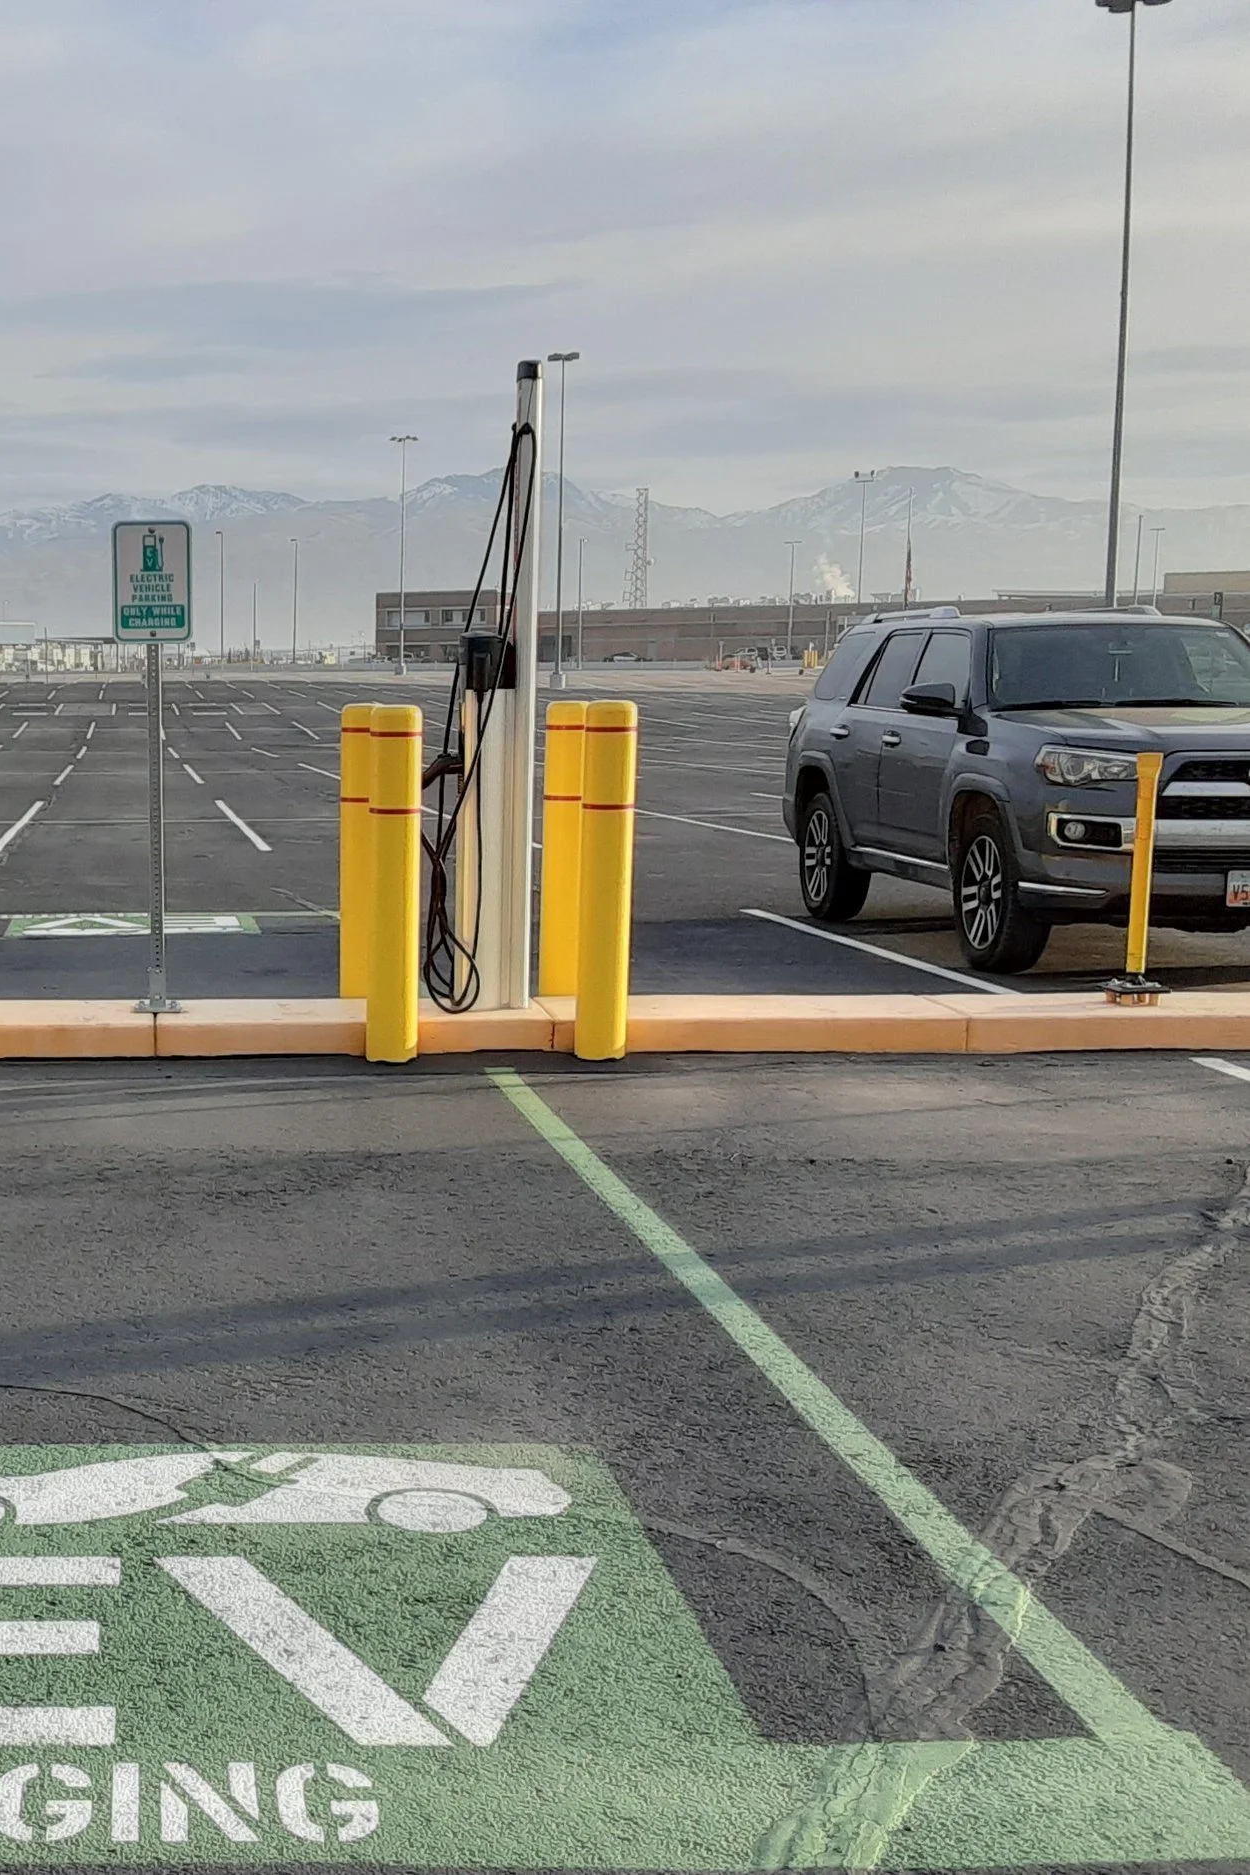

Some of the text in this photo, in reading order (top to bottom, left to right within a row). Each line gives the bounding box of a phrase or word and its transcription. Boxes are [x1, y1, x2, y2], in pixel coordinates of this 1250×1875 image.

[129, 573, 174, 583] ELECTRIC
[132, 583, 171, 593] VEHICLE
[131, 594, 173, 603] PARKING
[123, 606, 182, 616] ONLY WHILE
[129, 617, 176, 627] CHARGING
